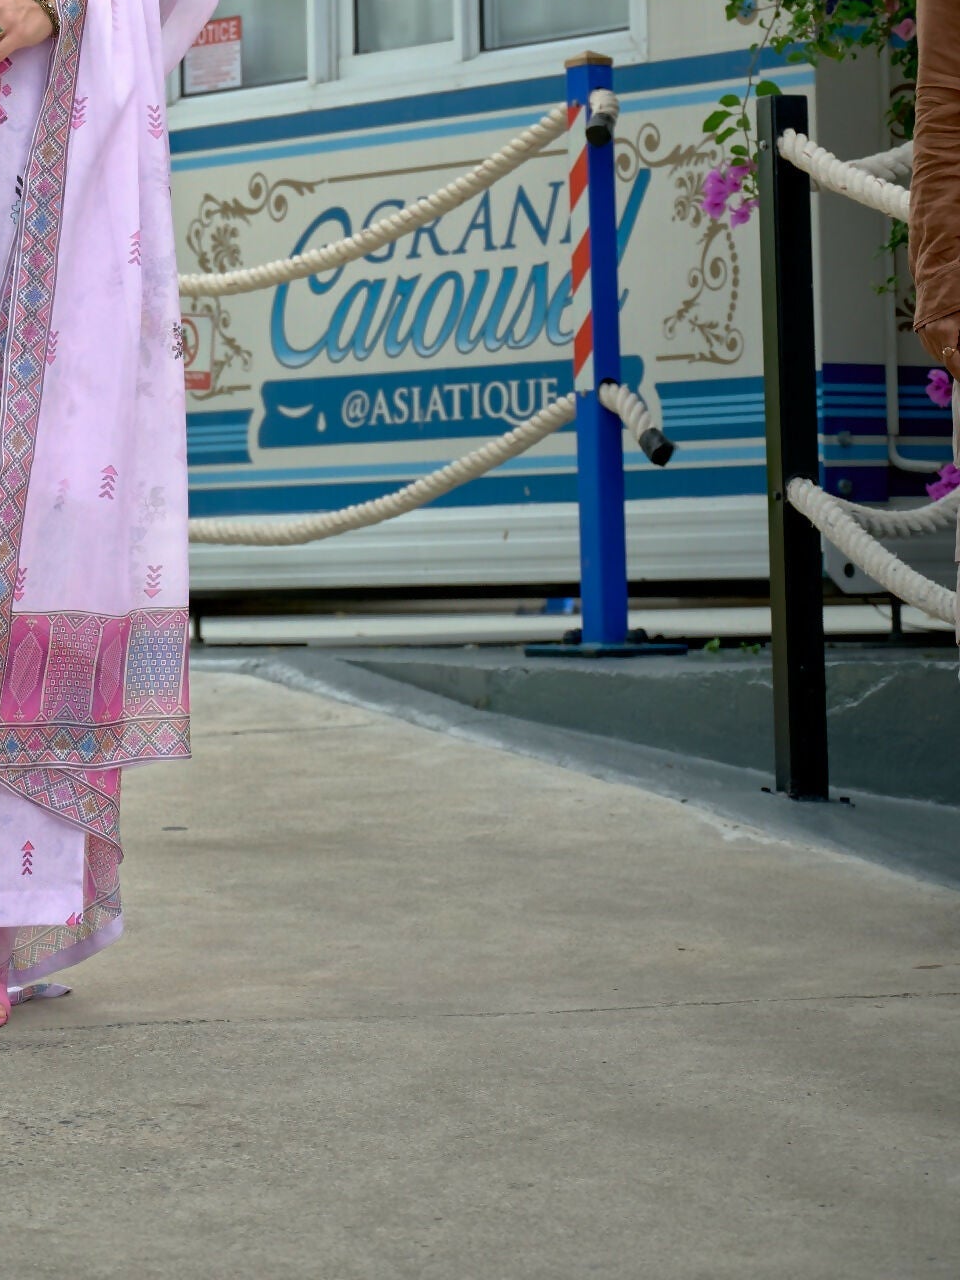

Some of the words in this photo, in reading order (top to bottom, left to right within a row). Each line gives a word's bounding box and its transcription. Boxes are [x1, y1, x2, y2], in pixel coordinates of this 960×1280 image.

[192, 20, 238, 44] OTICE
[361, 180, 571, 263] GRAN
[341, 377, 558, 429] @ASIATIQUE
